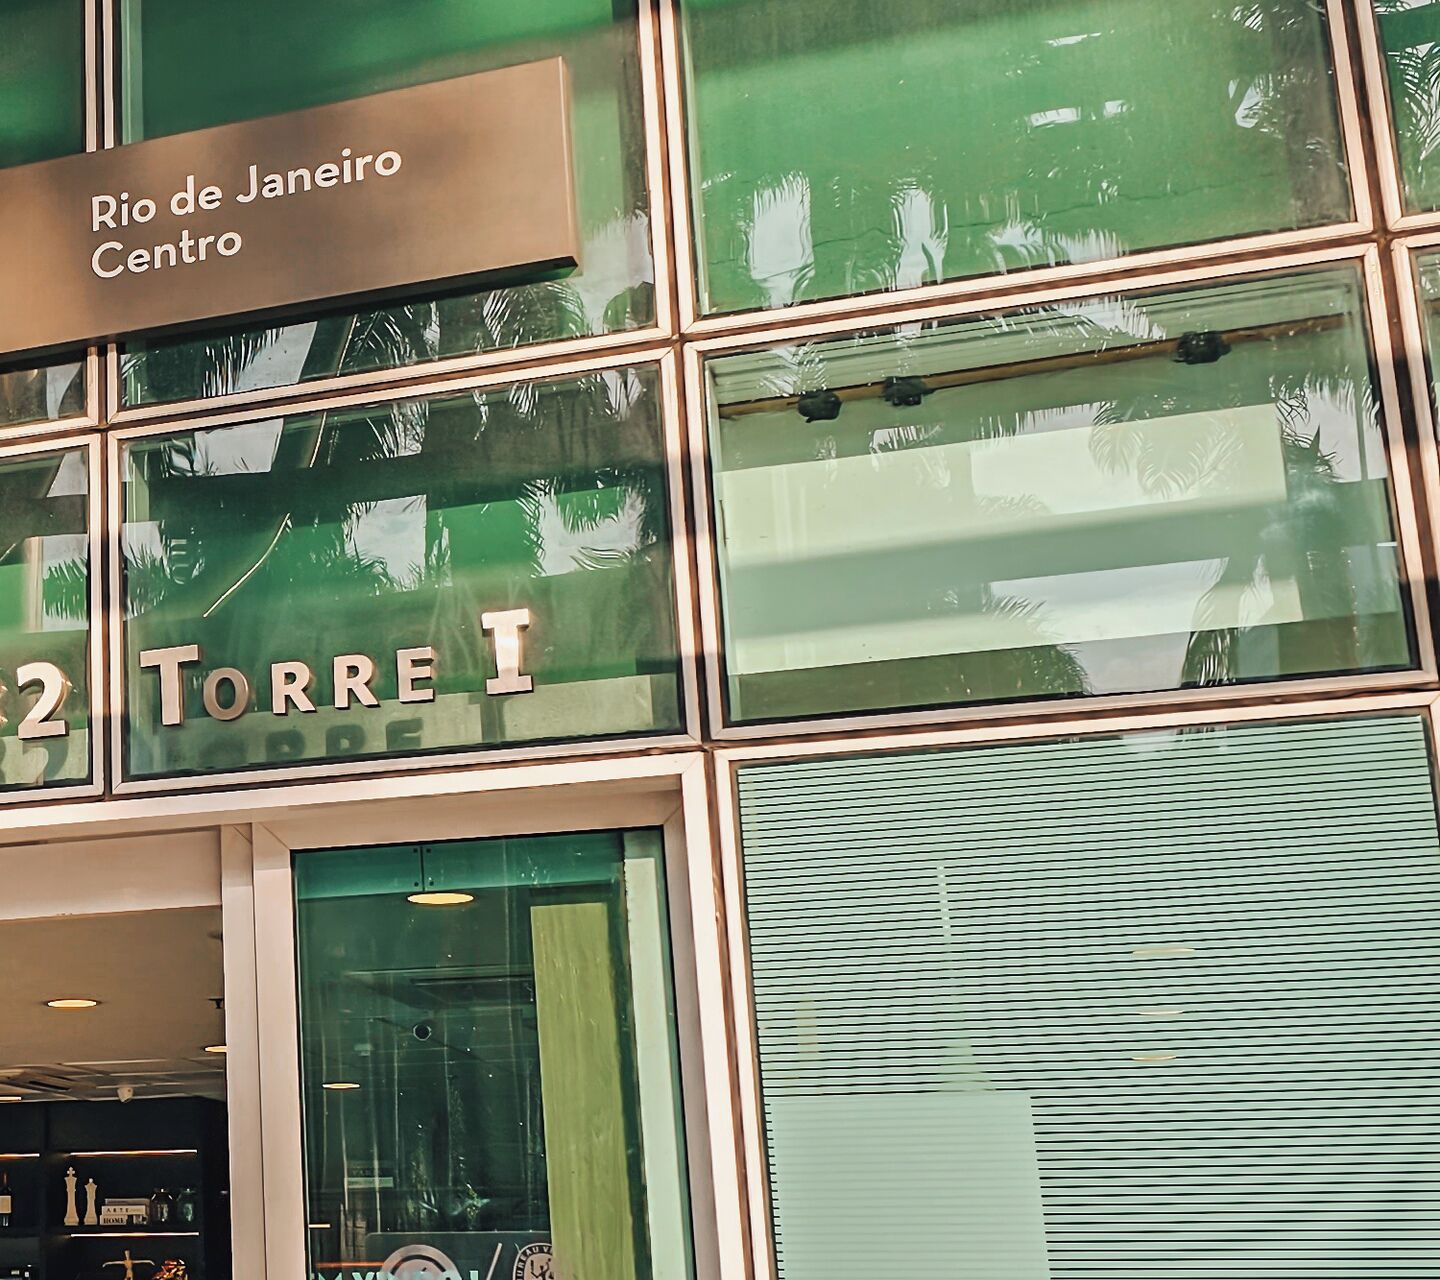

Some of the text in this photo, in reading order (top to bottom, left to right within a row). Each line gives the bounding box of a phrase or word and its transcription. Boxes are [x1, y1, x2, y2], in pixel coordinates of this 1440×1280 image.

[91, 148, 402, 232] Rio de Janeiro
[91, 229, 242, 279] Centro
[139, 645, 437, 727] TORRE
[481, 608, 534, 695] I
